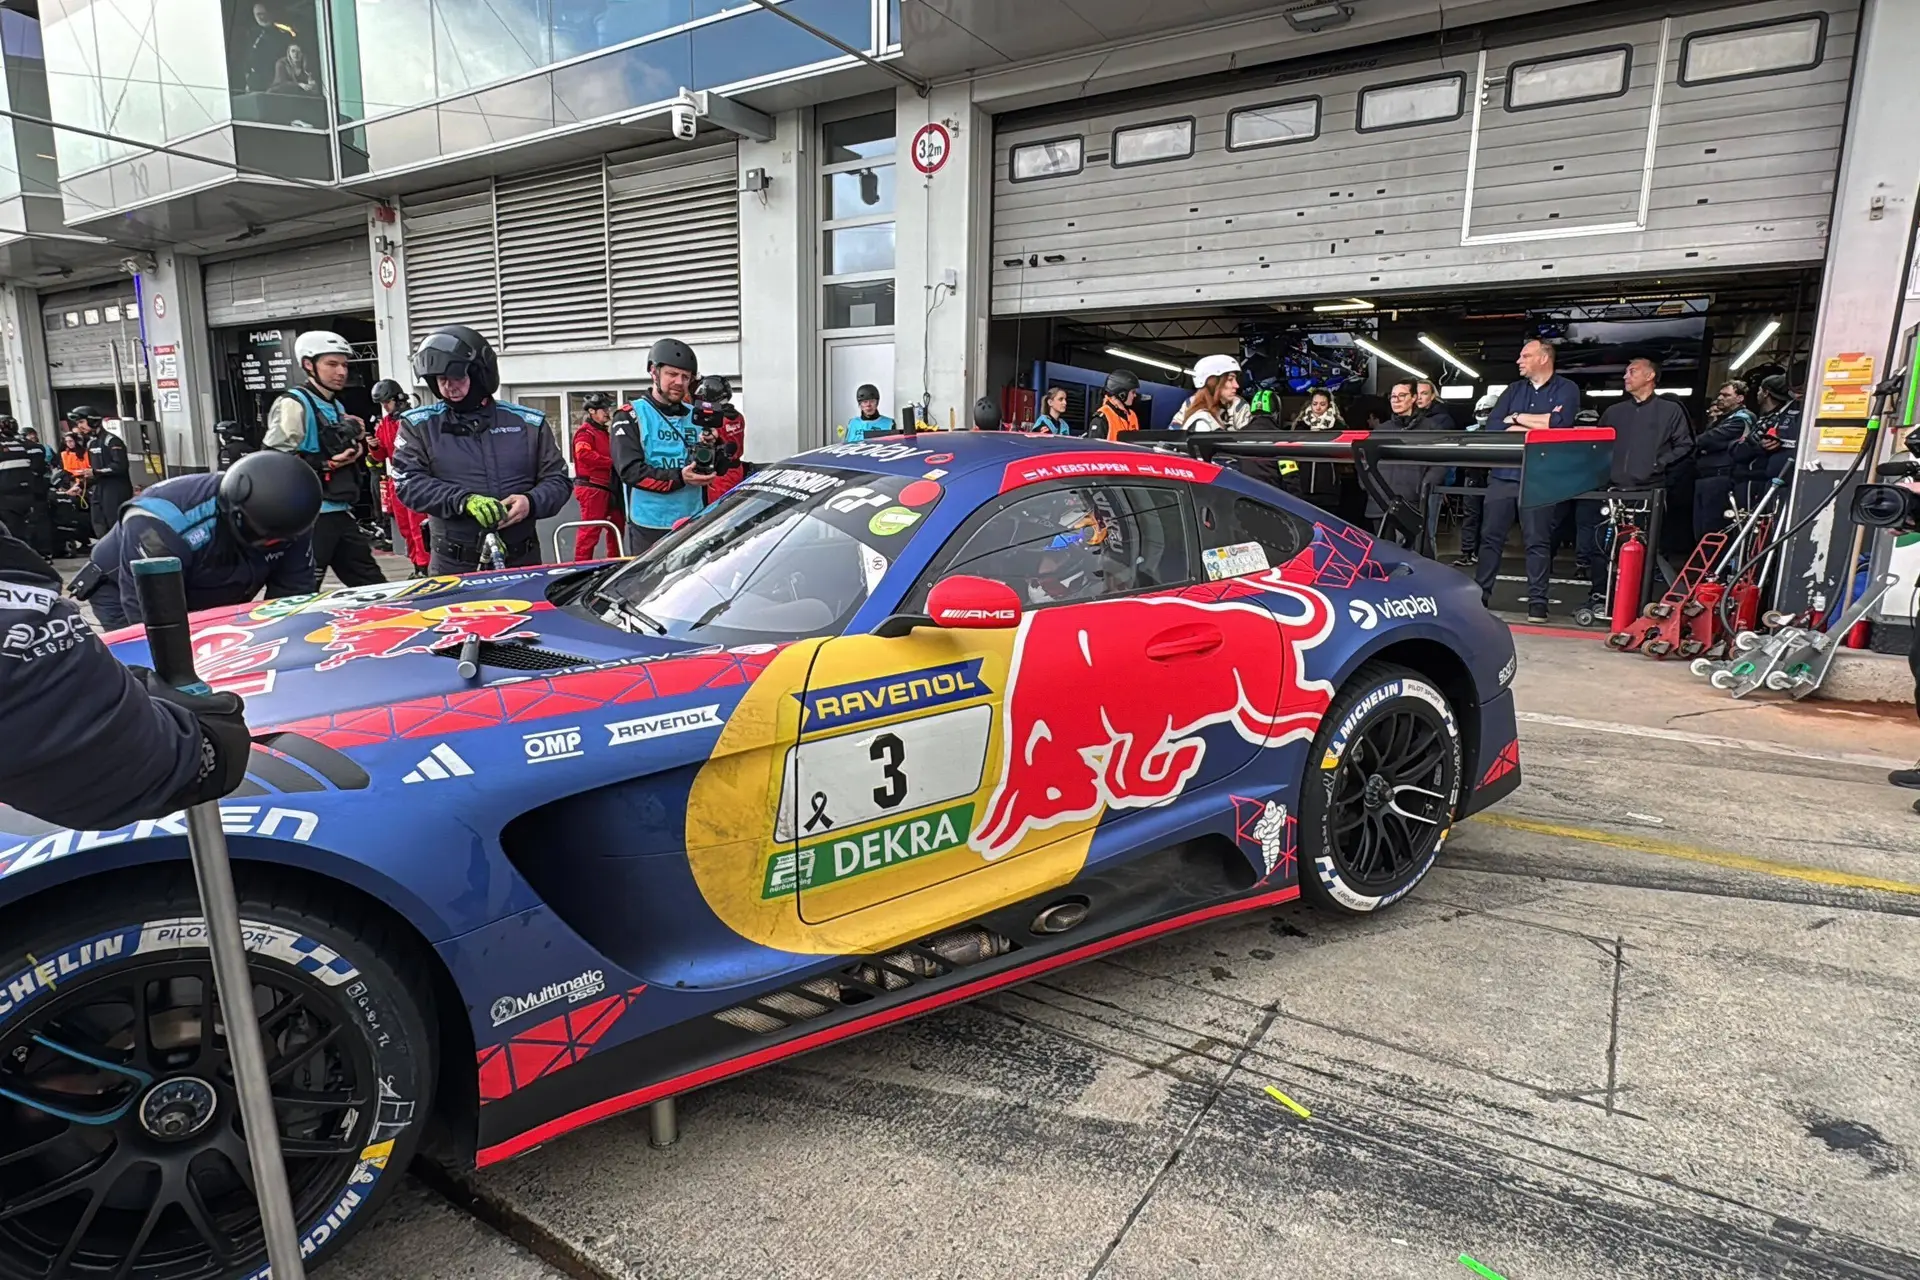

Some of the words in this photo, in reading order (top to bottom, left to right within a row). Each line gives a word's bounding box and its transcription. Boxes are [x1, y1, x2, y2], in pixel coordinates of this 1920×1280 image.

[249, 329, 283, 343] HWA
[1055, 463, 1130, 475] VERSTAPPEN
[1164, 467, 1196, 480] AUER
[458, 572, 544, 588] viaplay
[964, 609, 1015, 619] AMG
[1376, 595, 1438, 620] viaplay
[815, 671, 976, 720] RAVENOL
[1407, 683, 1424, 693] PILOT
[617, 709, 713, 739] RAVENOL
[1340, 682, 1399, 739] MICHELIN
[524, 730, 582, 759] OMP
[869, 732, 908, 810] 3
[833, 812, 960, 878] DEKRA
[516, 969, 604, 1012] Multimatic
